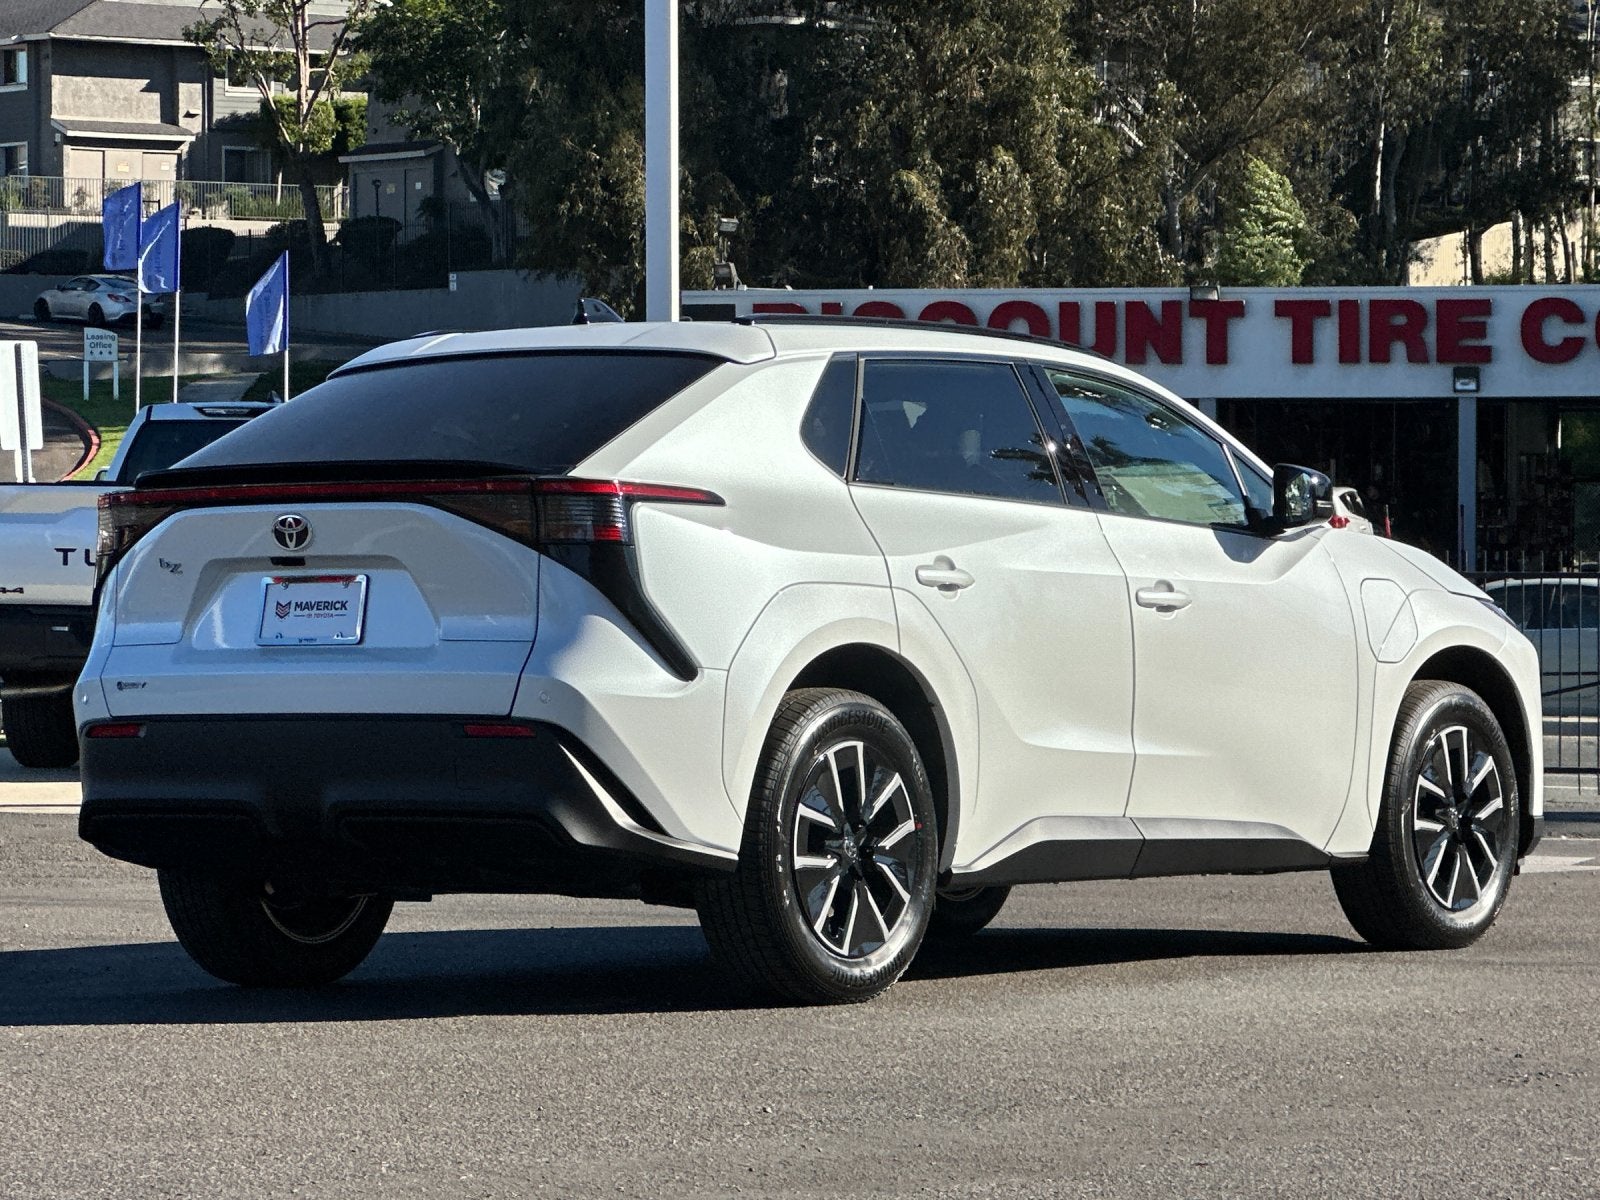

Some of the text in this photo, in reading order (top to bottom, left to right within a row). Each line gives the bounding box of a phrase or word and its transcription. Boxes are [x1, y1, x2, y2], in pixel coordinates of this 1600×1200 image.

[86, 333, 116, 341] Leasing
[753, 297, 1600, 365] OUNT TIRE C
[294, 600, 349, 612] MAVERICK
